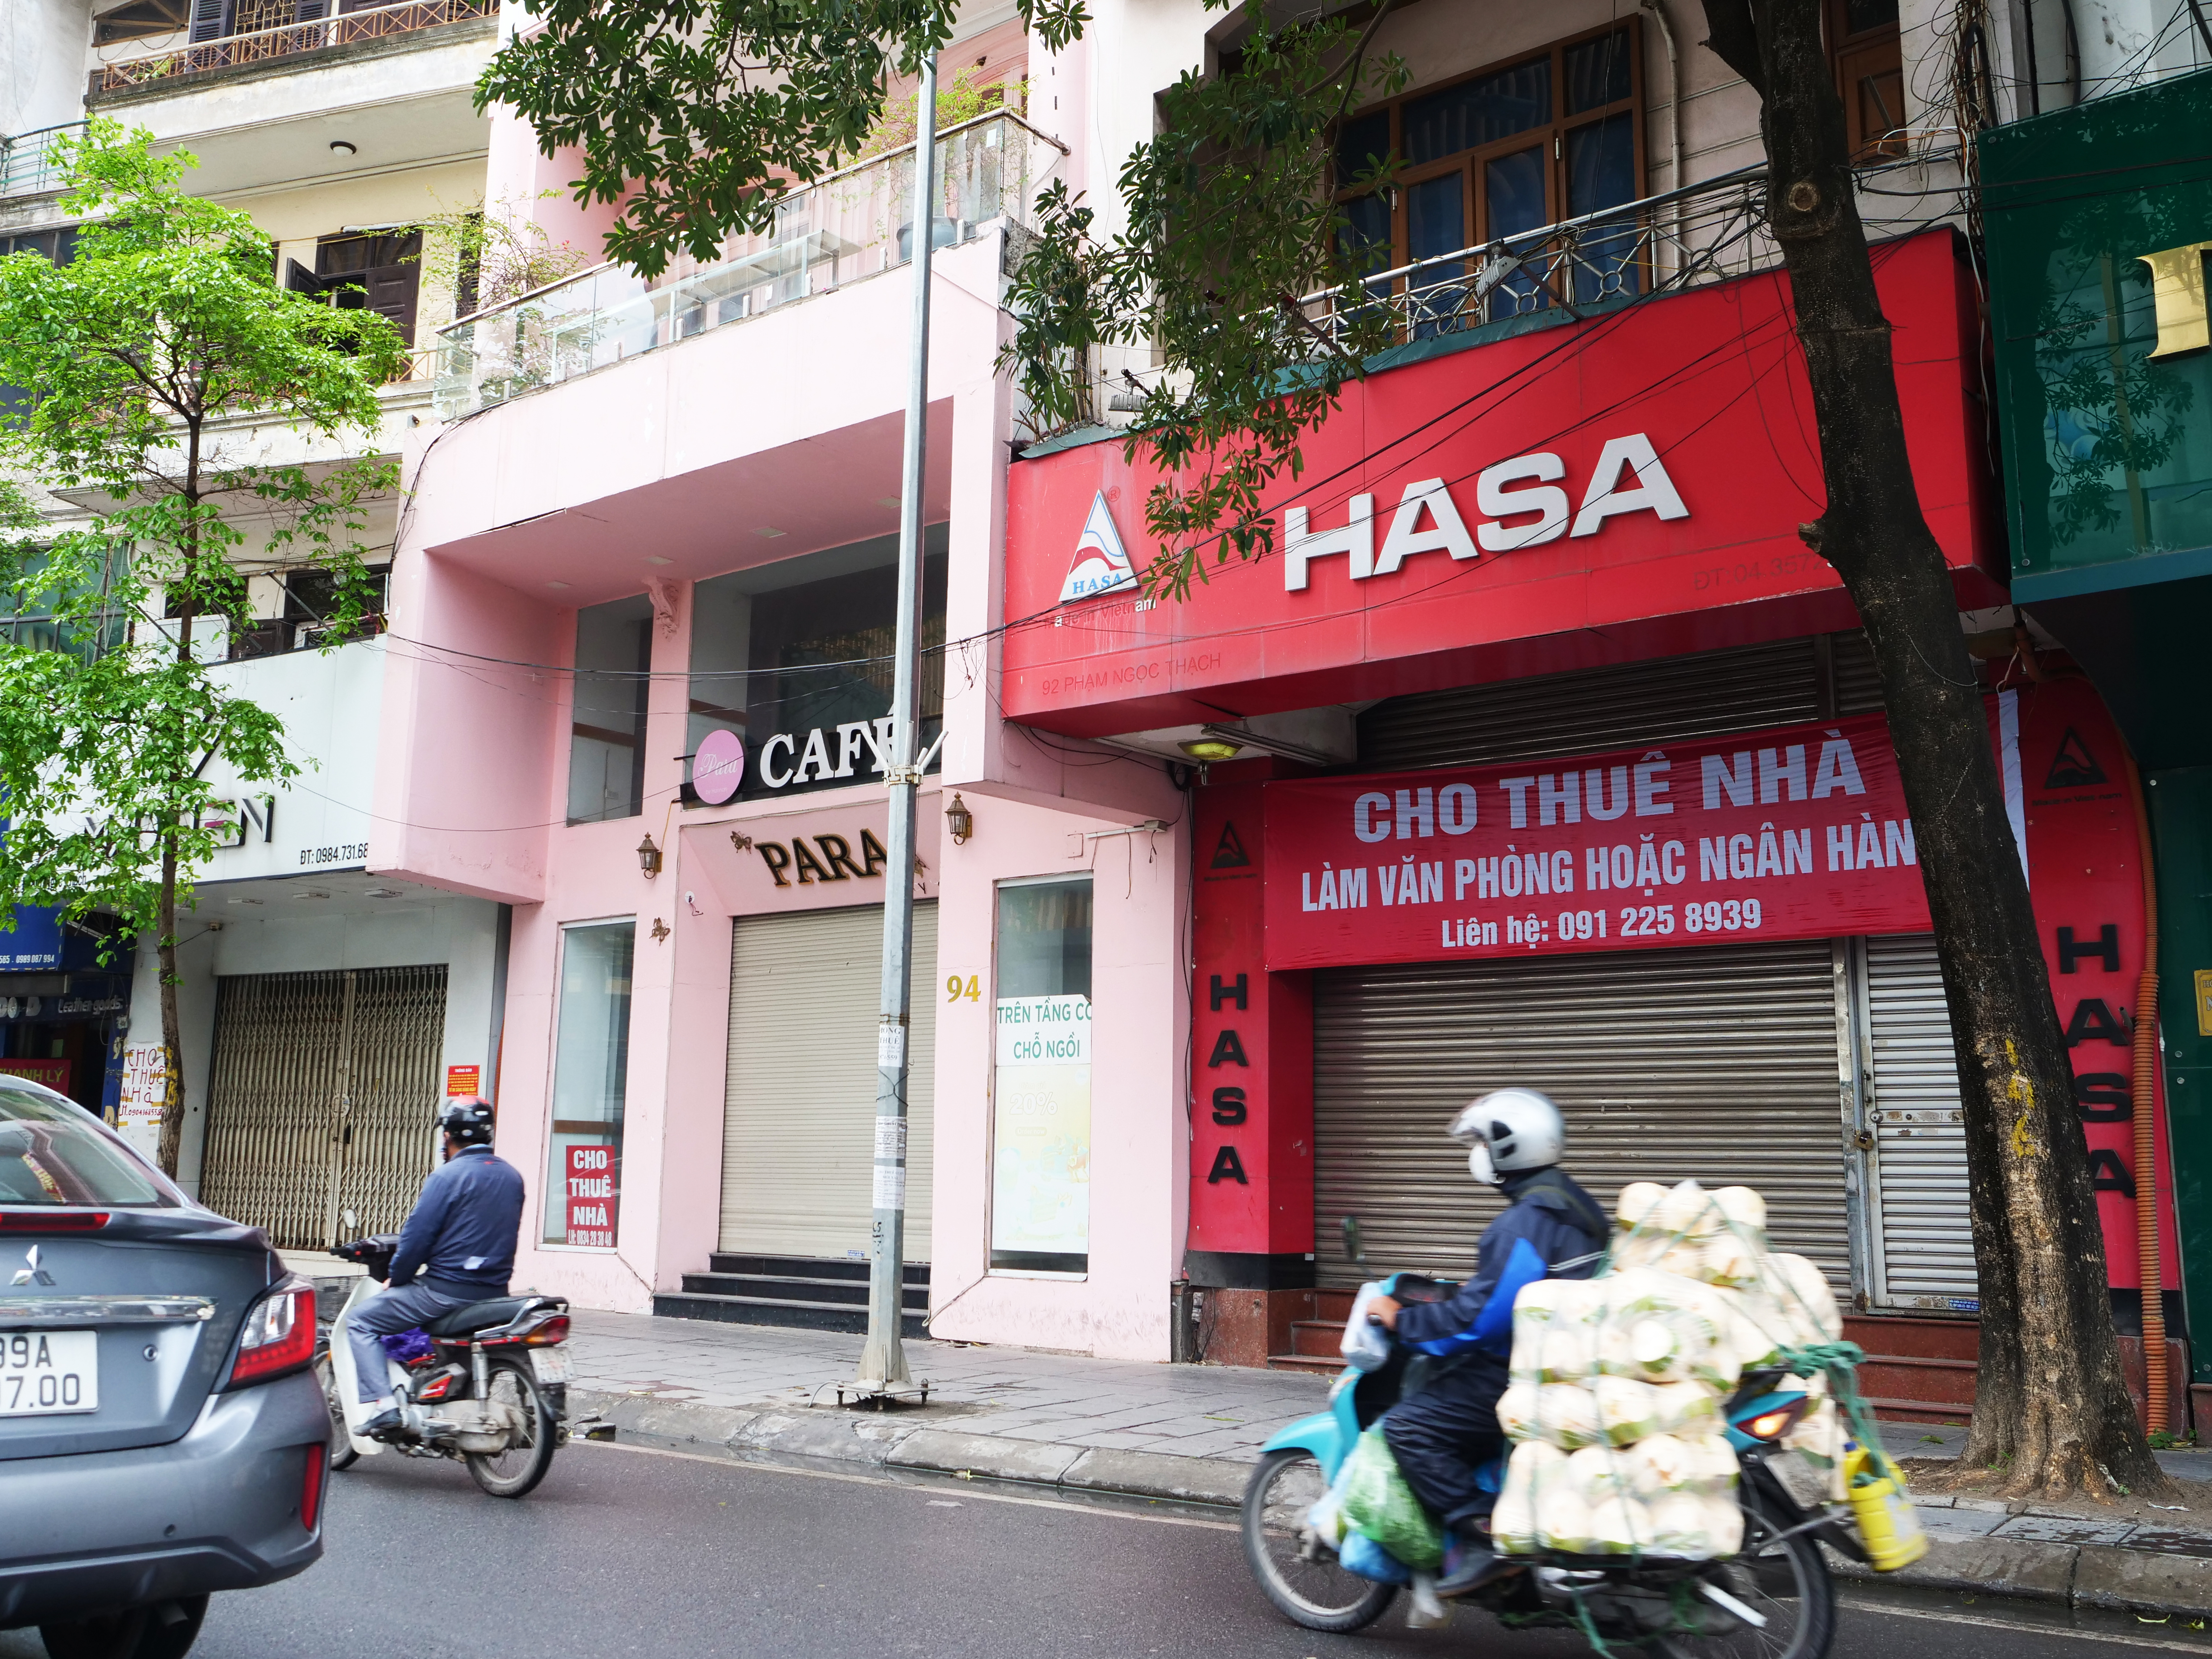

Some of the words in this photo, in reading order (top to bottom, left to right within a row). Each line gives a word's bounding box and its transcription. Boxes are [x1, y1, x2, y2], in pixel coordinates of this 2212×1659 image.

[1284, 432, 1691, 592] HASA
[1072, 573, 1123, 594] HASA
[1042, 679, 1059, 695] 92
[1064, 671, 1108, 692] PHẠM
[1113, 662, 1160, 684] NGỌC
[1164, 652, 1221, 676] THẠCH
[1354, 783, 1477, 843] CHO
[1499, 751, 1674, 830] THUÊ
[1700, 728, 1866, 810] NHÀ
[300, 849, 314, 865] ĐT:
[754, 828, 887, 887] PARA
[1302, 861, 1368, 912] LÀM
[1378, 856, 1444, 907] VĂN
[1455, 844, 1574, 901] PHÒNG
[1585, 832, 1687, 897] HOẶC
[1698, 821, 1813, 882] NGÂN
[1442, 919, 1498, 948] Liên
[1507, 913, 1549, 949] hệ:
[1558, 908, 1607, 941] 091
[1620, 904, 1675, 937] 225
[1685, 898, 1762, 934] 8939
[16, 955, 30, 964] 0989
[31, 955, 42, 963] 087
[43, 954, 55, 963] 994
[947, 975, 981, 1003] 94
[997, 1001, 1031, 1024] TRÊN
[1035, 996, 1071, 1022] TẦNG
[1013, 1032, 1042, 1059] CHỖ
[1046, 1031, 1080, 1058] NGỒI
[128, 1048, 157, 1067] CHO
[46, 1066, 64, 1082] LÝ
[131, 1066, 166, 1085] THUÊ
[1207, 973, 1248, 1185] HASA
[1009, 1091, 1058, 1115] 20%
[573, 1149, 607, 1169] CHO
[569, 1174, 611, 1197] THUÊ
[573, 1203, 608, 1226] NHÀ
[577, 1229, 589, 1246] 0834
[590, 1230, 597, 1246] 28
[597, 1230, 604, 1246] 38
[605, 1231, 612, 1246] 48
